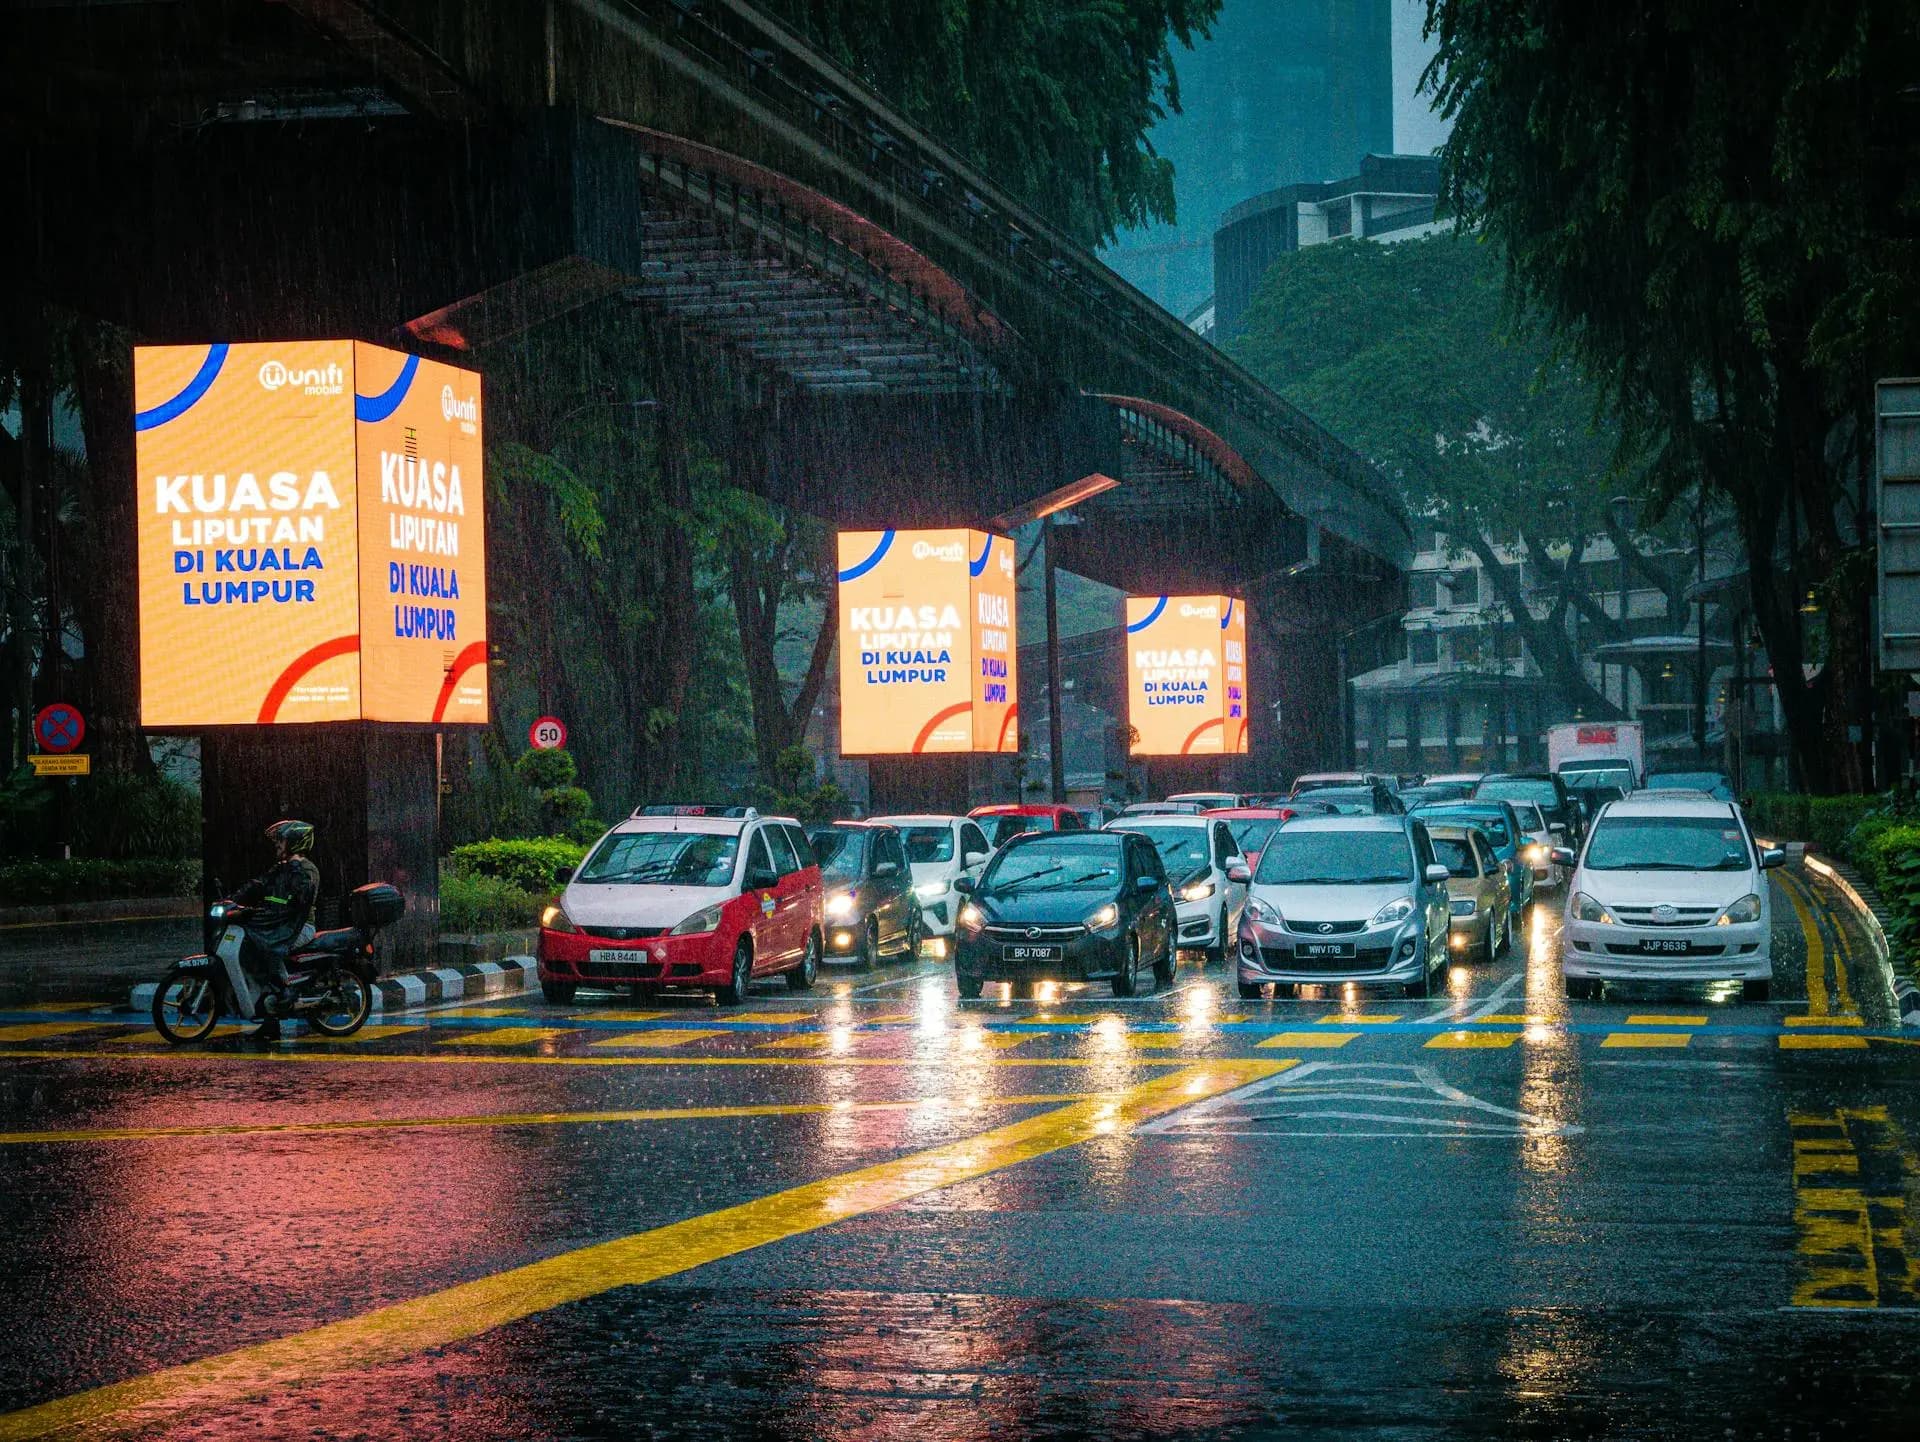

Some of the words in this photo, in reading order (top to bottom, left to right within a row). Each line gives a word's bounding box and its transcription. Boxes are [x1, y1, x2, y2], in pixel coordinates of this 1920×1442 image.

[304, 385, 343, 395] mobile
[155, 471, 340, 513] KUASA
[381, 451, 465, 516] KUASA
[172, 515, 324, 546] LIPUTAN
[390, 513, 459, 557] LIPUTAN
[174, 550, 204, 573] DI
[216, 547, 324, 572] KUALA
[389, 562, 406, 594] DI
[410, 565, 460, 600] KUALA
[183, 580, 315, 605] LUMPUR
[850, 605, 961, 630] KUASA
[978, 592, 1009, 628] KUASA
[395, 604, 456, 640] LUMPUR
[860, 631, 953, 650] LIPUTAN
[861, 652, 880, 665] DI
[887, 650, 951, 664] KUALA
[1136, 649, 1217, 668] KUASA
[867, 669, 946, 684] LUMPUR
[989, 659, 1008, 679] KUALA
[1143, 668, 1209, 681] LIPUTAN
[984, 683, 1007, 703] LUMPUR
[1144, 682, 1158, 692] DI
[1162, 681, 1208, 691] KUALA
[1148, 695, 1205, 705] LUMPUR
[540, 728, 558, 741] 50
[1014, 948, 1029, 958] BPJ
[1031, 948, 1051, 958] 7087
[1327, 945, 1341, 954] 178
[1643, 941, 1661, 951] JJP
[1662, 941, 1687, 951] 9636
[600, 952, 617, 961] HBA
